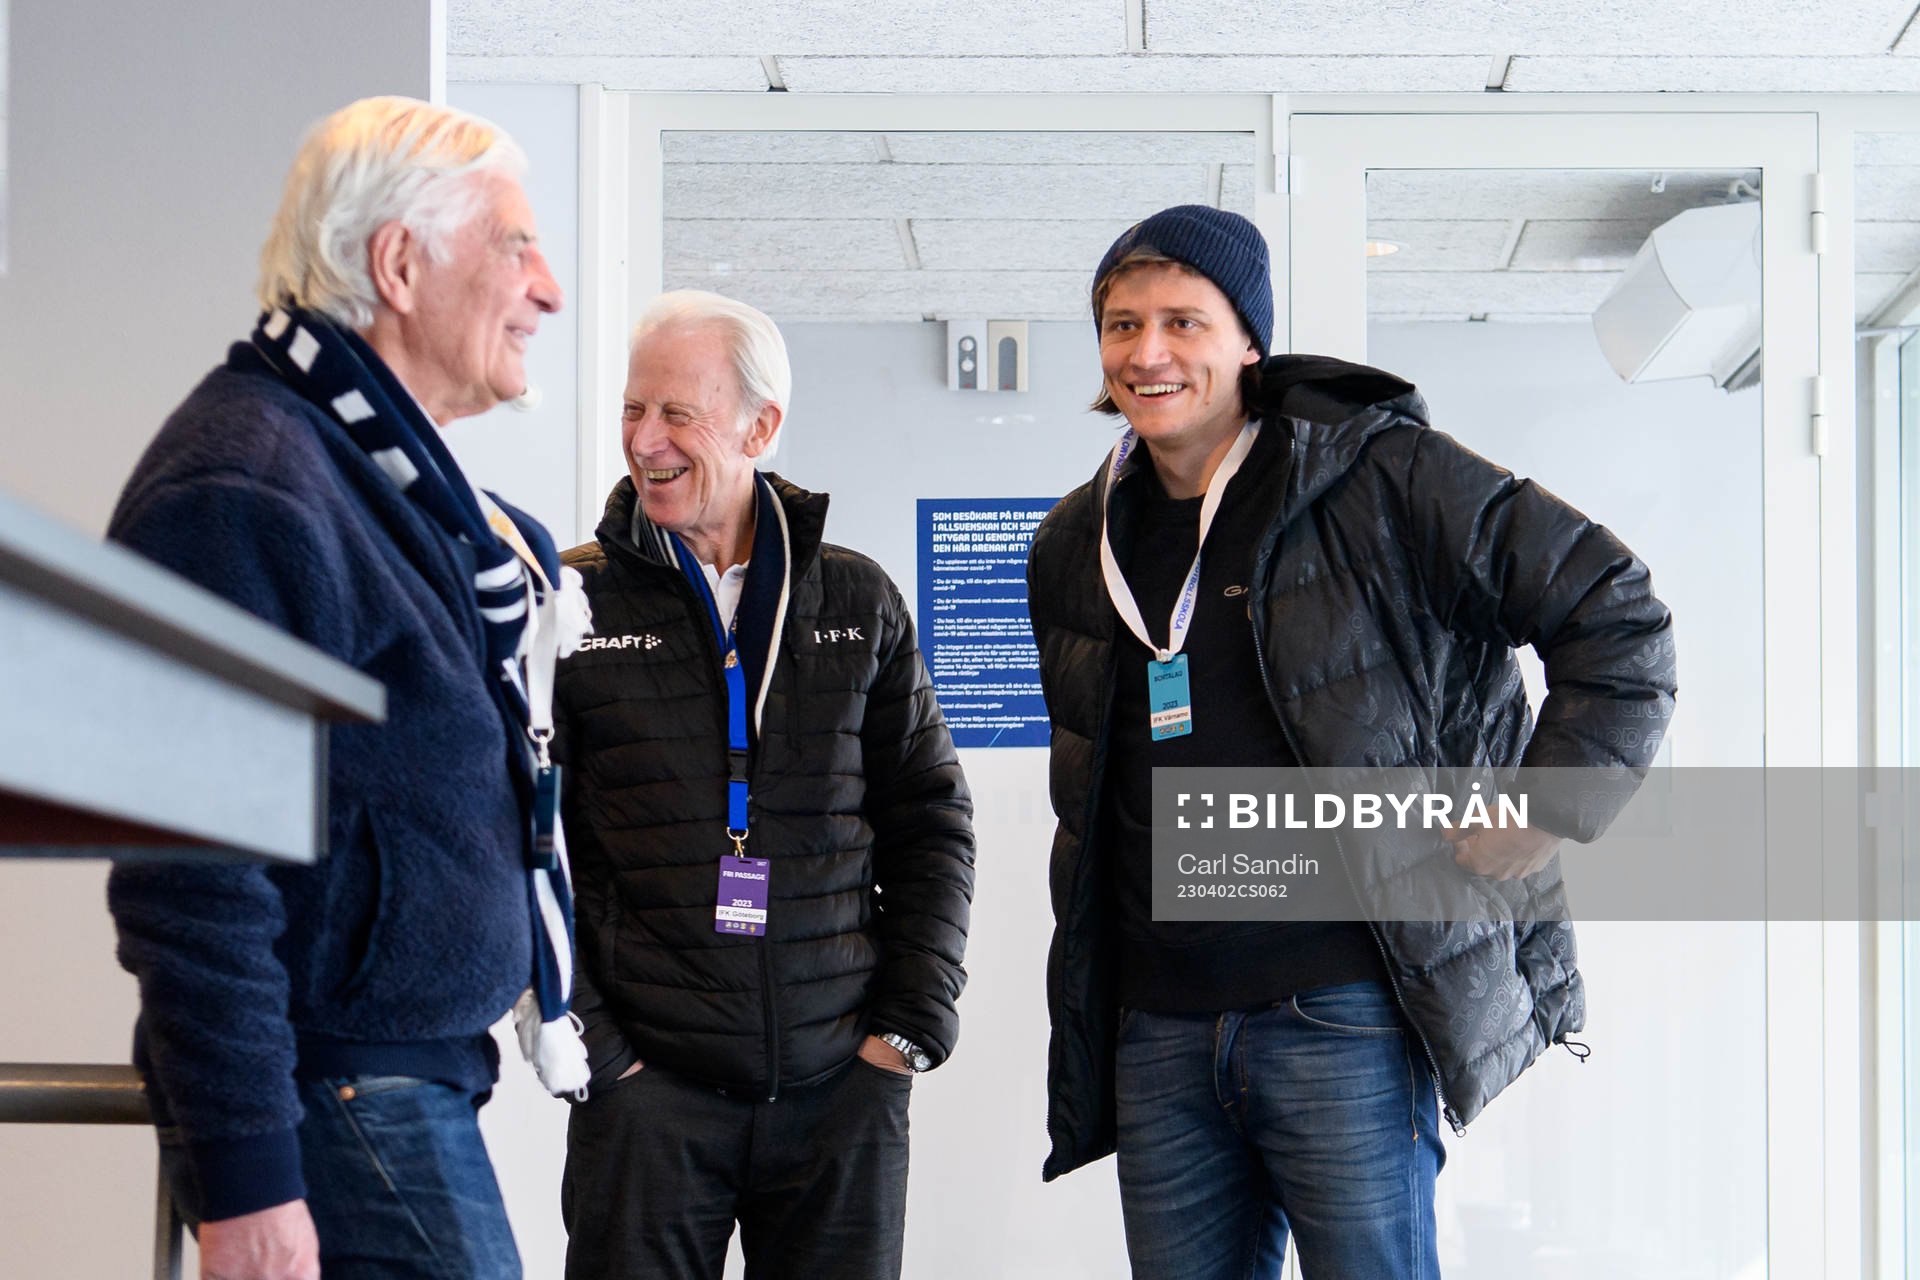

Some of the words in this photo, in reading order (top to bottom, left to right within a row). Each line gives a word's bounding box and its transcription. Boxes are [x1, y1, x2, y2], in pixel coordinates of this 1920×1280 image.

[933, 512, 951, 521] SOM
[953, 511, 998, 520] BESÖKARE
[1000, 510, 1012, 520] PÅ
[1013, 511, 1025, 520] EN
[933, 523, 936, 531] I
[937, 522, 999, 531] ALLSVENSKAN
[1001, 522, 1018, 531] OCH
[933, 533, 970, 542] INTYGAR
[971, 533, 984, 542] DU
[985, 533, 1015, 542] GENOM
[1016, 533, 1034, 541] ATT
[933, 544, 951, 553] DEN
[952, 542, 971, 552] HÄR
[971, 544, 1006, 552] ARENAN
[1008, 543, 1028, 552] ATT:
[577, 635, 642, 652] CRAFT
[732, 899, 752, 907] 2023
